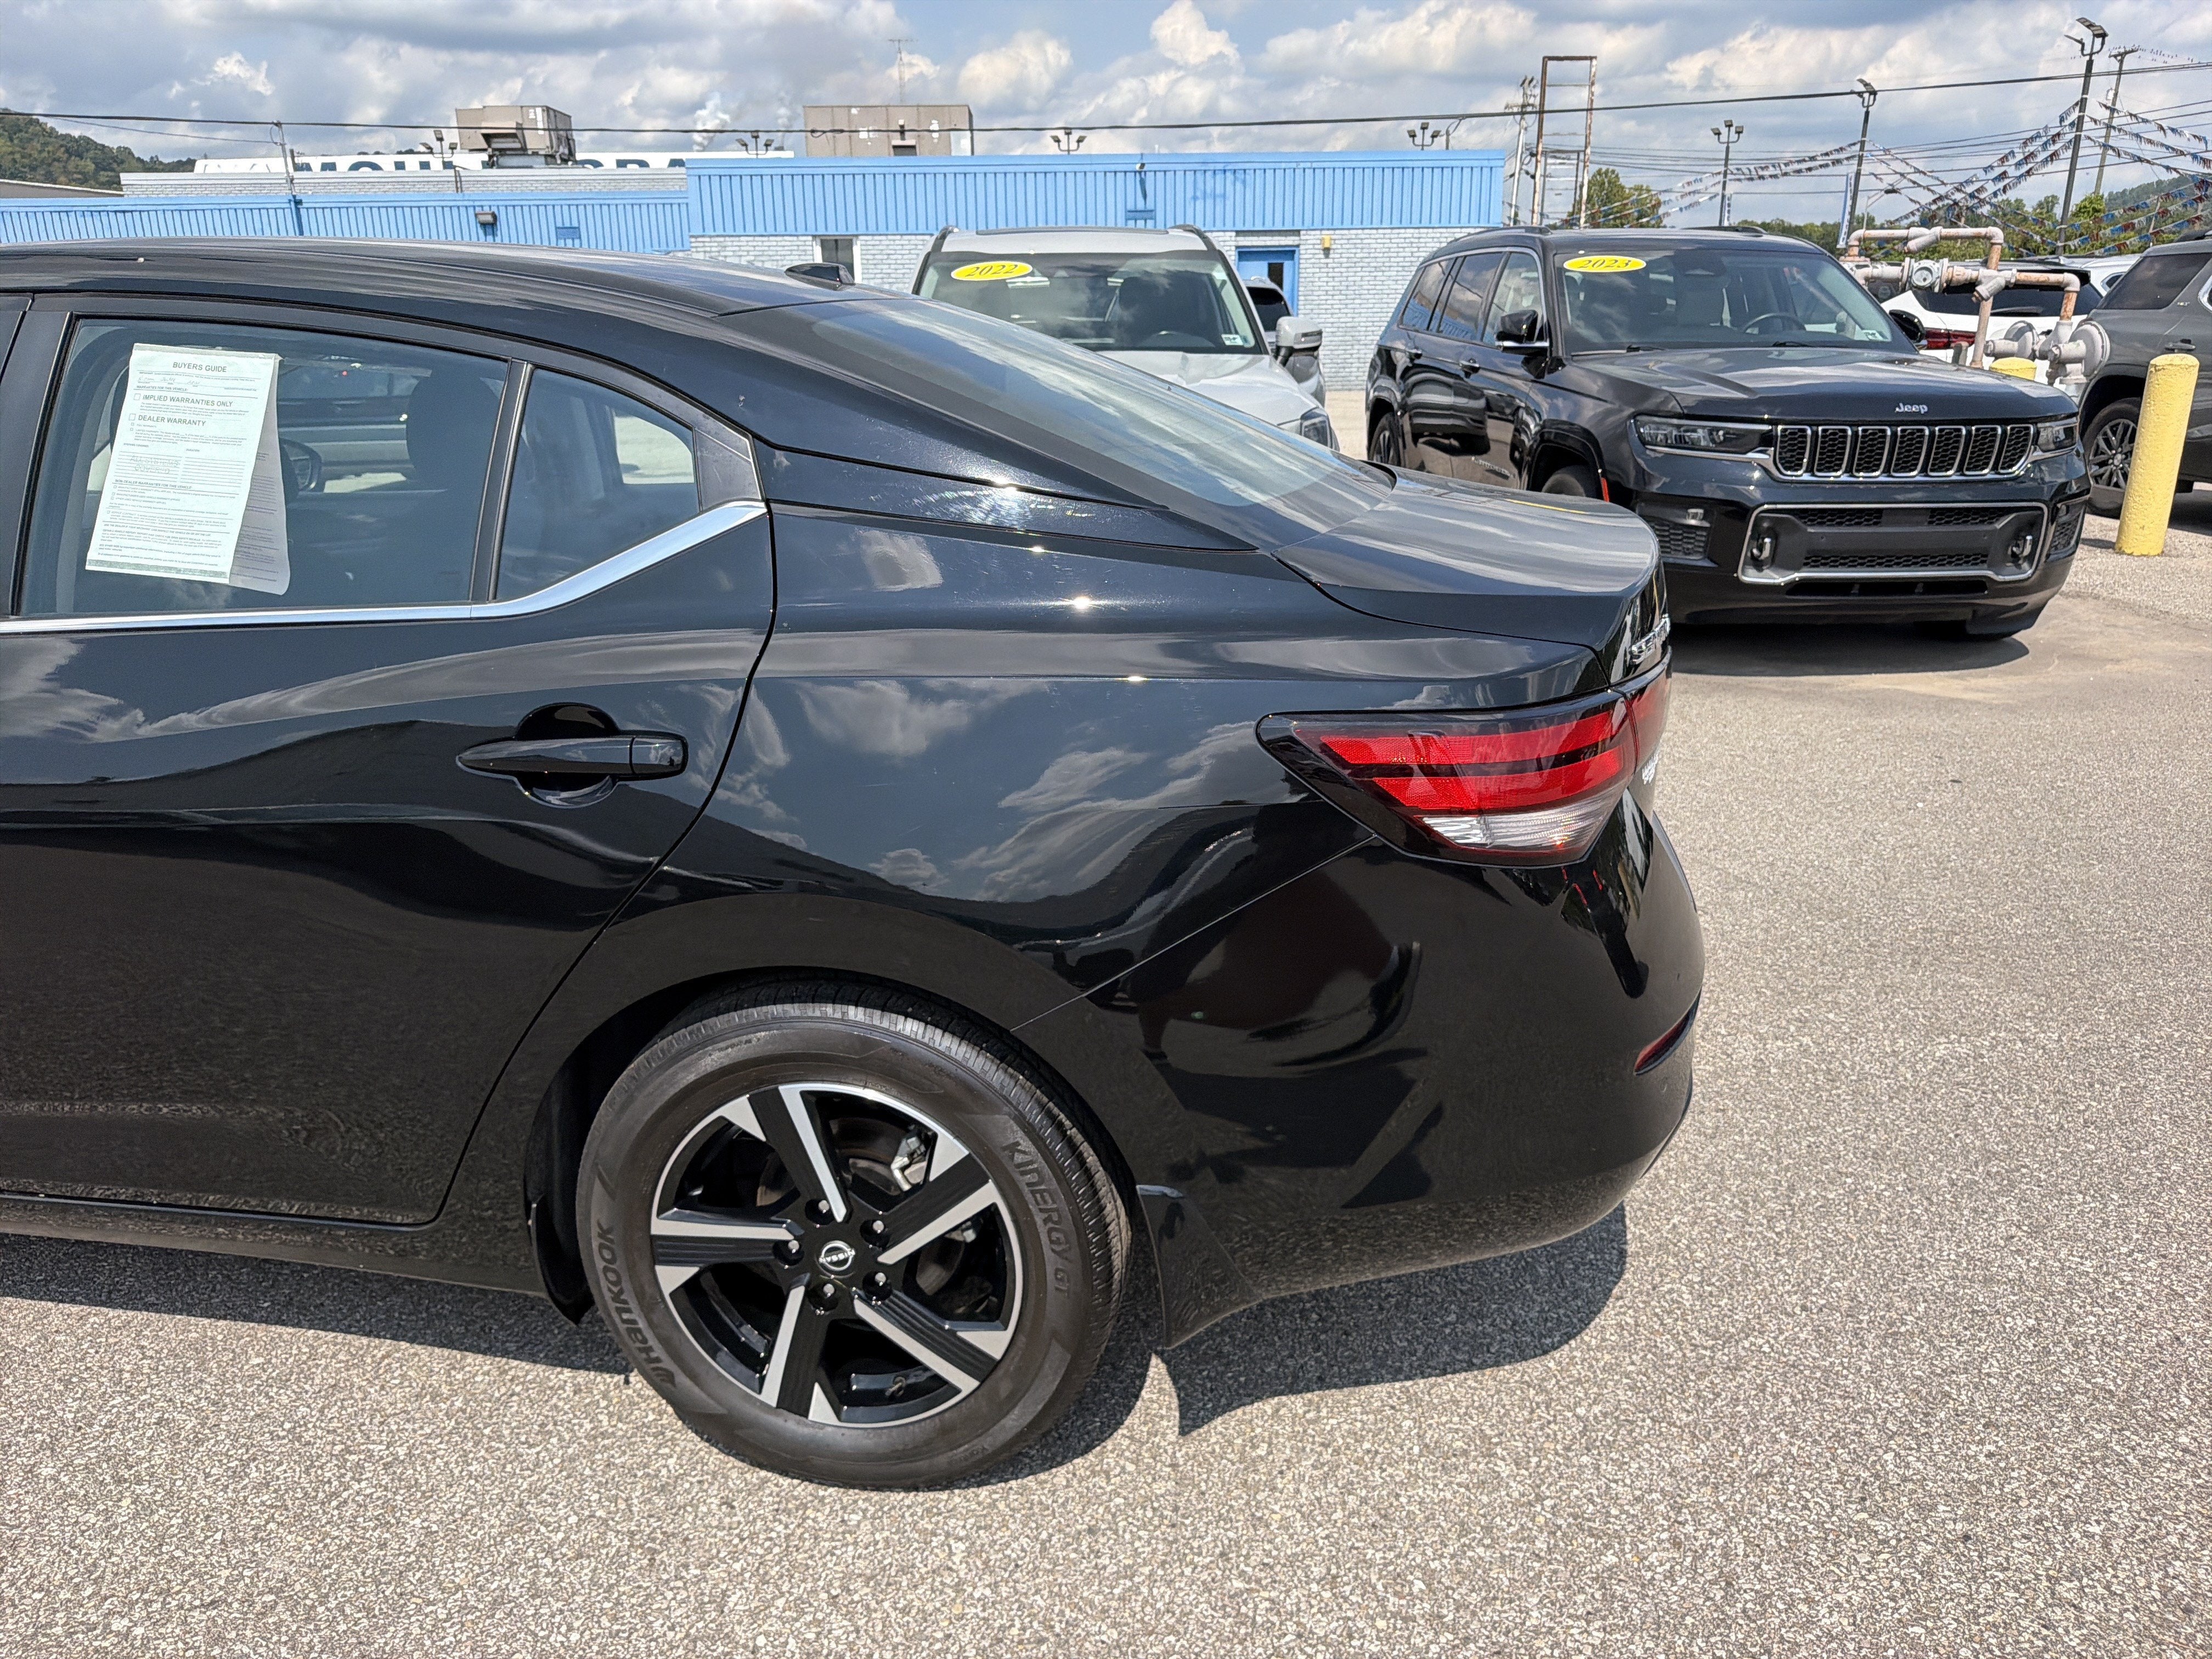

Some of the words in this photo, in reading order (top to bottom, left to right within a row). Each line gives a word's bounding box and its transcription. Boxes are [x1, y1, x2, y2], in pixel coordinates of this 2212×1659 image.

[1577, 259, 1632, 268] 2023
[964, 264, 1018, 277] 2022
[172, 362, 203, 371] BUYERS
[170, 396, 215, 407] WARRANTIES
[1895, 403, 1928, 414] Jeep
[167, 417, 206, 426] WARRANTY
[1000, 1141, 1072, 1261] KINERGY
[1054, 1267, 1069, 1296] GT
